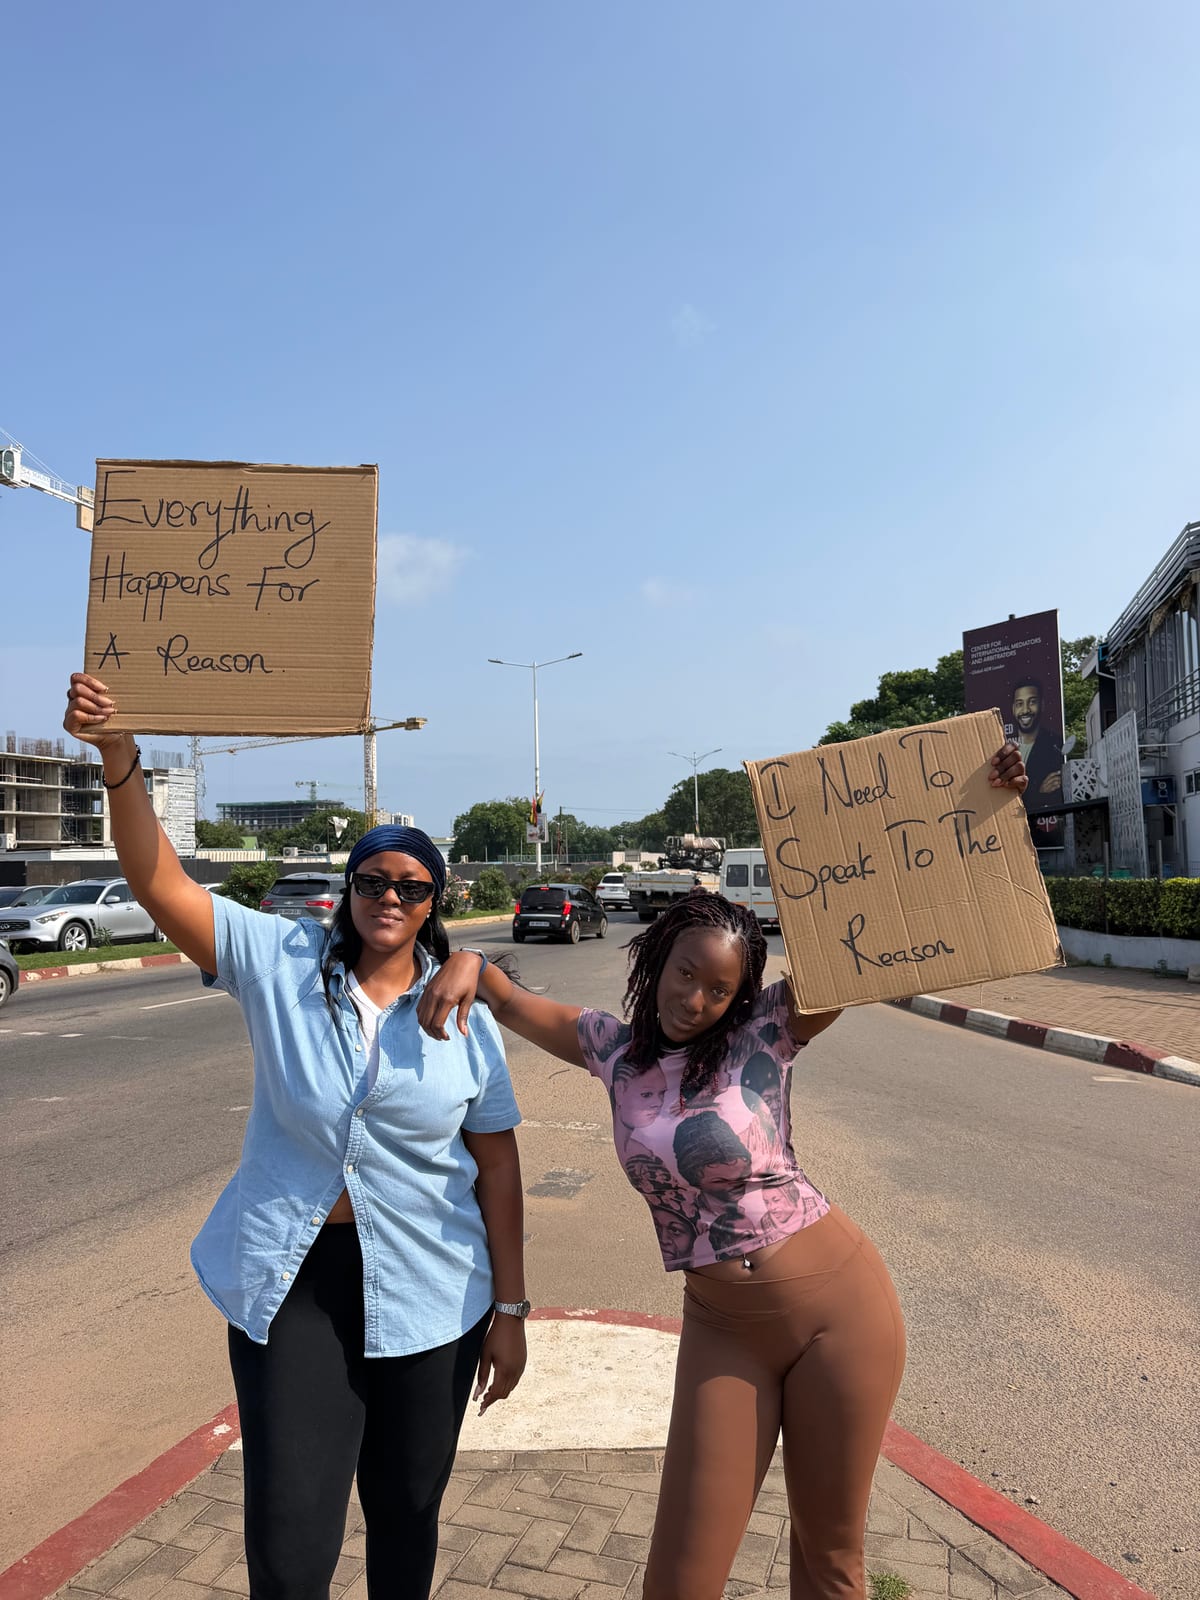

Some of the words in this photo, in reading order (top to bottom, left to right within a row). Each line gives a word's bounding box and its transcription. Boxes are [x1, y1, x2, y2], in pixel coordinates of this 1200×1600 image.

[96, 470, 331, 570] Everything
[91, 551, 230, 622] Happens
[247, 566, 320, 611] For
[93, 632, 130, 669] A
[970, 644, 990, 652] CENTER
[991, 640, 1001, 648] FOR
[970, 646, 1011, 658] INTERNATIONAL
[1011, 637, 1041, 649] MEDIATORS
[760, 761, 796, 820] I
[817, 750, 895, 815] Need
[899, 730, 954, 791] To
[776, 837, 876, 911] Speak
[884, 819, 934, 871] To
[938, 809, 1002, 858] The
[840, 913, 955, 975] Reason
